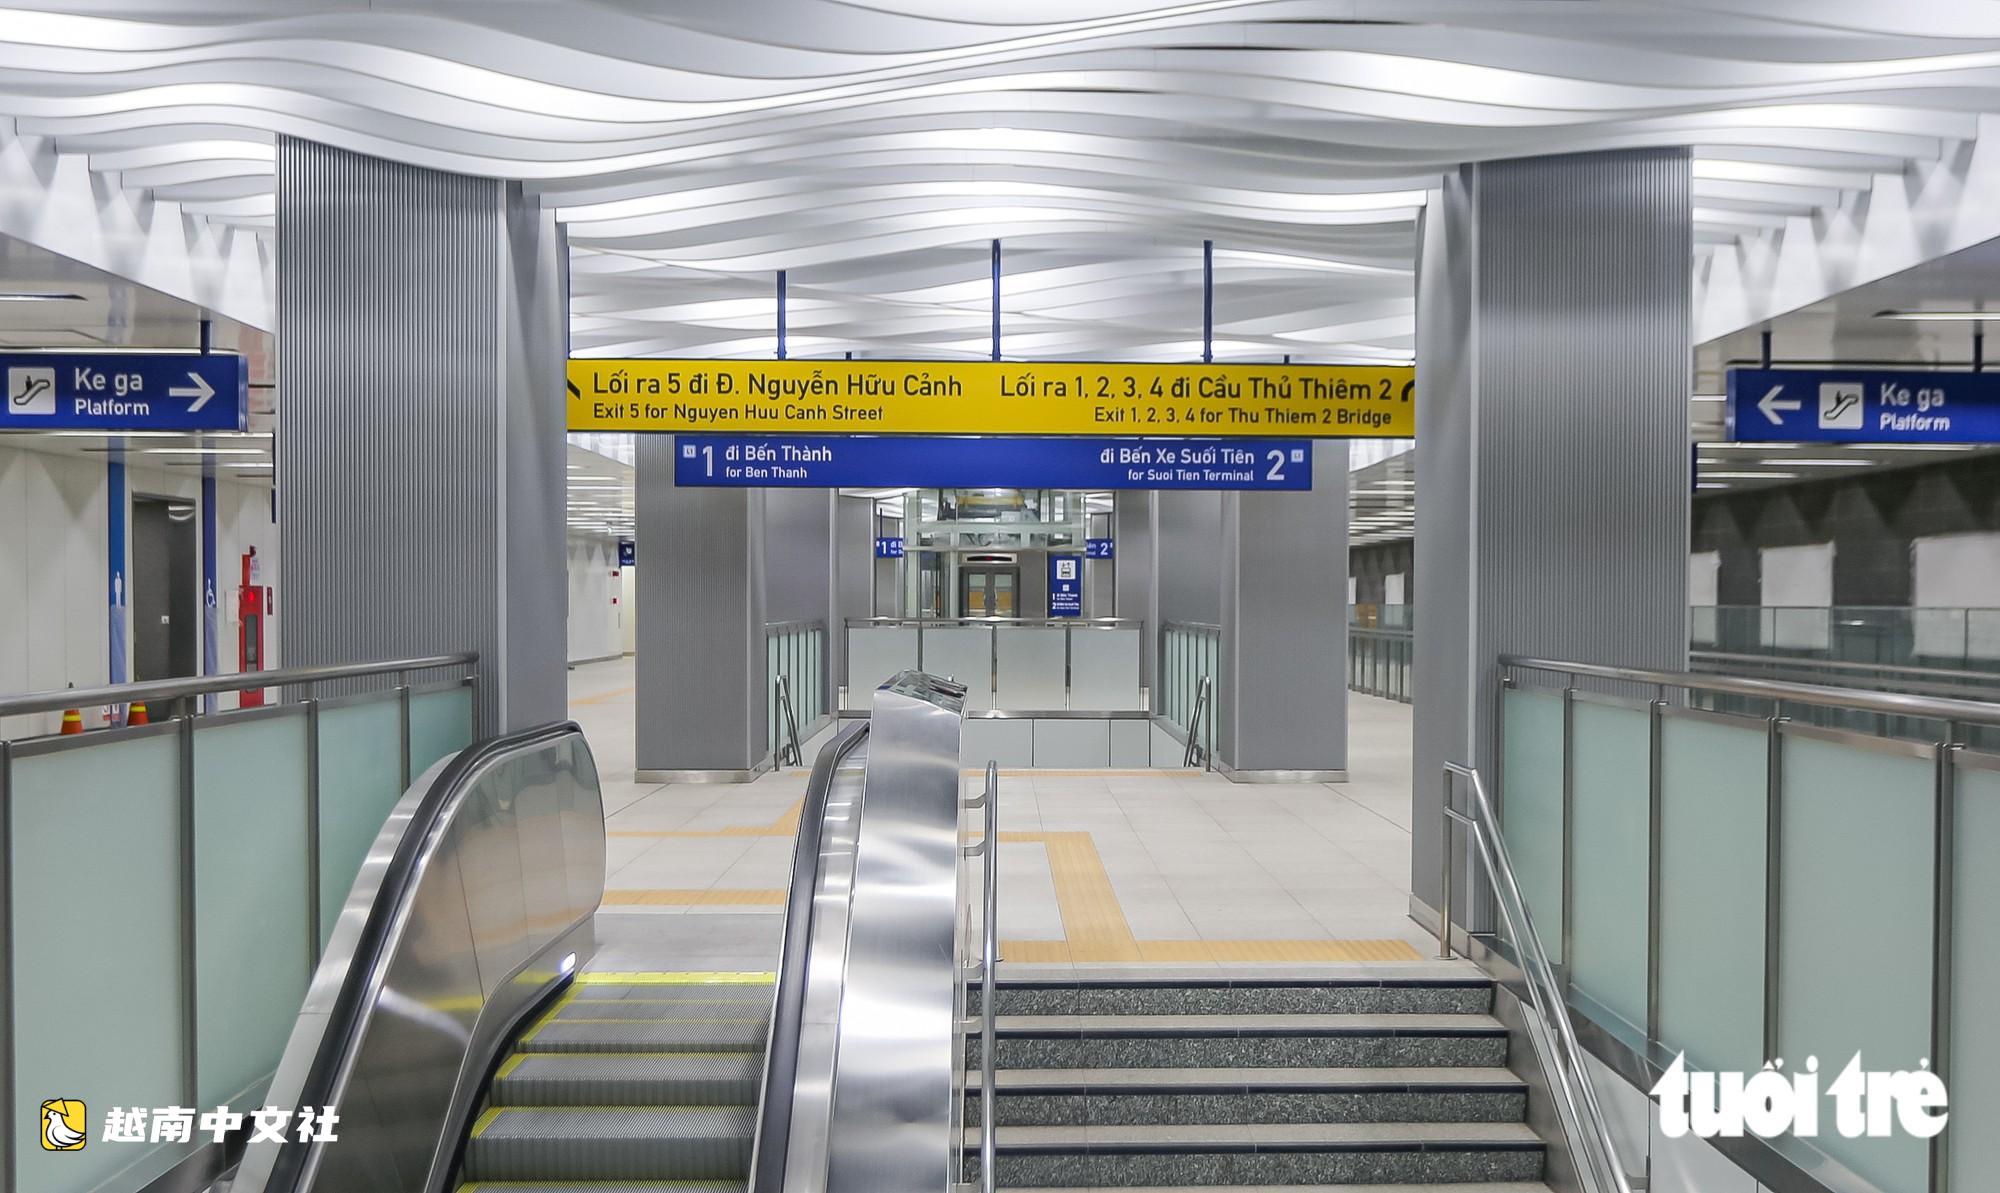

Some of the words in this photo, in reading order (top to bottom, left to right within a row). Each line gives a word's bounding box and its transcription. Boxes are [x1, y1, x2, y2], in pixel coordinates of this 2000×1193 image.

[75, 367, 106, 390] Ke
[114, 374, 143, 396] ga
[593, 369, 628, 394] Lối
[636, 378, 660, 394] ra
[668, 372, 681, 394] 5
[689, 373, 708, 394] đi
[716, 373, 740, 395] Đ.
[748, 370, 838, 401] Nguyễn
[847, 373, 895, 396] Hữu
[903, 372, 962, 396] Cảnh
[1001, 372, 1035, 397] Lối
[1043, 381, 1067, 397] ra
[1075, 375, 1089, 399] 1,
[1097, 376, 1116, 399] 2,
[1123, 376, 1143, 400] 3,
[1149, 376, 1164, 398] 4
[1171, 376, 1190, 398] đi
[1198, 374, 1241, 399] Cầu
[1247, 375, 1292, 400] Thủ
[1298, 377, 1372, 401] Thiêm
[1378, 378, 1393, 401] 2
[75, 398, 150, 416] Platform
[1881, 384, 1910, 406] Ke
[1917, 390, 1944, 413] ga
[593, 402, 625, 419] Exit
[630, 403, 639, 419] 5
[644, 403, 668, 419] for
[674, 403, 739, 423] Nguyen
[745, 404, 779, 420] Huu
[785, 404, 827, 420] Canh
[832, 404, 883, 420] Street
[1095, 406, 1125, 422] Exit
[1130, 407, 1142, 423] 1,
[1147, 407, 1161, 423] 2,
[1166, 407, 1181, 423] 3,
[1185, 407, 1195, 423] 4
[1200, 407, 1224, 423] for
[1228, 407, 1260, 424] Thu
[1264, 407, 1317, 424] Thiem
[1322, 407, 1332, 425] 2
[1337, 407, 1392, 429] Bridge
[1879, 412, 1951, 431] Platform
[702, 445, 713, 477] 1
[725, 444, 740, 461] đi
[745, 442, 776, 461] Bến
[781, 445, 832, 462] Thành
[1100, 447, 1114, 464] đi
[1119, 446, 1151, 464] Bến
[1155, 448, 1176, 464] Xe
[1180, 446, 1216, 464] Suối
[1220, 448, 1255, 465] Tiên
[725, 466, 743, 479] for
[745, 466, 768, 479] Ben
[770, 466, 808, 479] Thanh
[1128, 468, 1145, 481] for
[1147, 468, 1173, 481] Suoi
[1175, 468, 1200, 481] Tien
[1203, 468, 1254, 482] Terminal
[1266, 449, 1285, 481] 2
[881, 541, 887, 555] 1
[1100, 542, 1108, 556] 2
